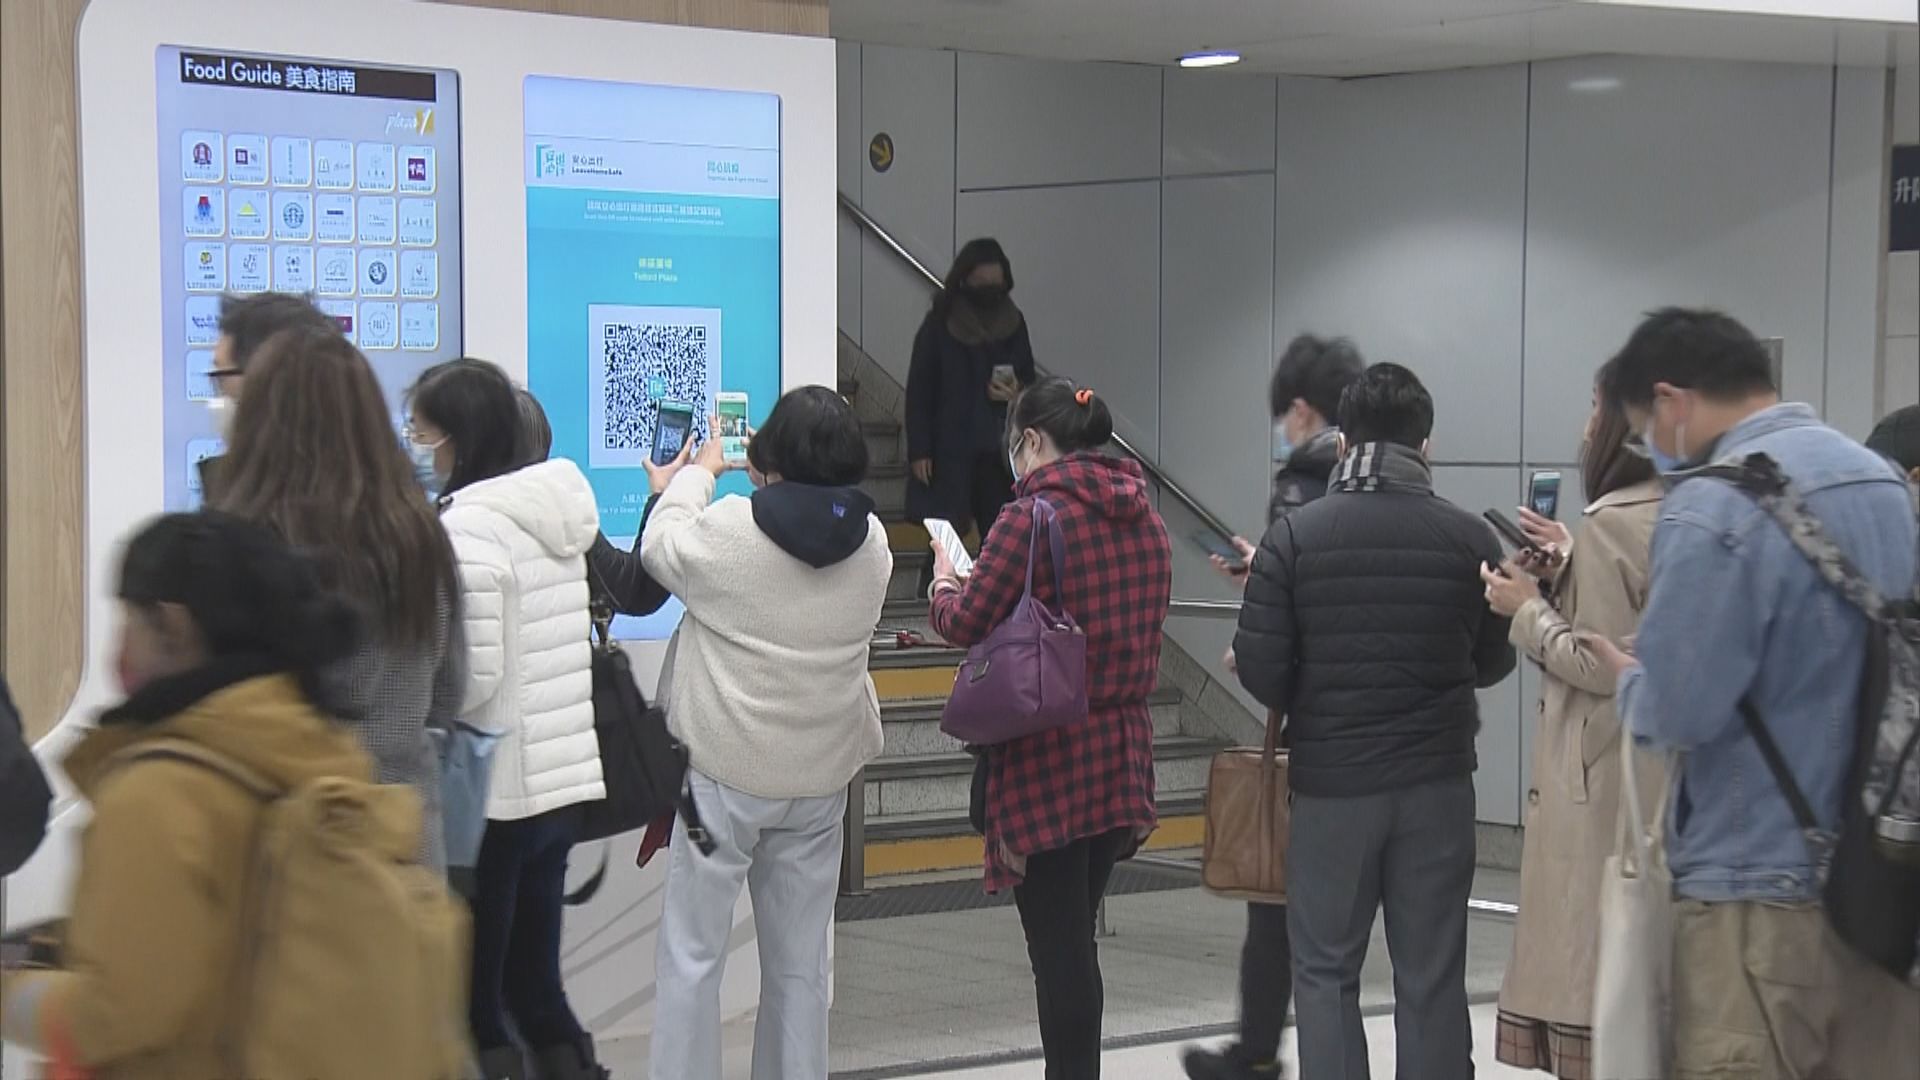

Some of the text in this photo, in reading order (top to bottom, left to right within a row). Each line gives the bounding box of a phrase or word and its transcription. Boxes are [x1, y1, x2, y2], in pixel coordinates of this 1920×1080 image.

[184, 58, 356, 93] Food Guide 美食指南
